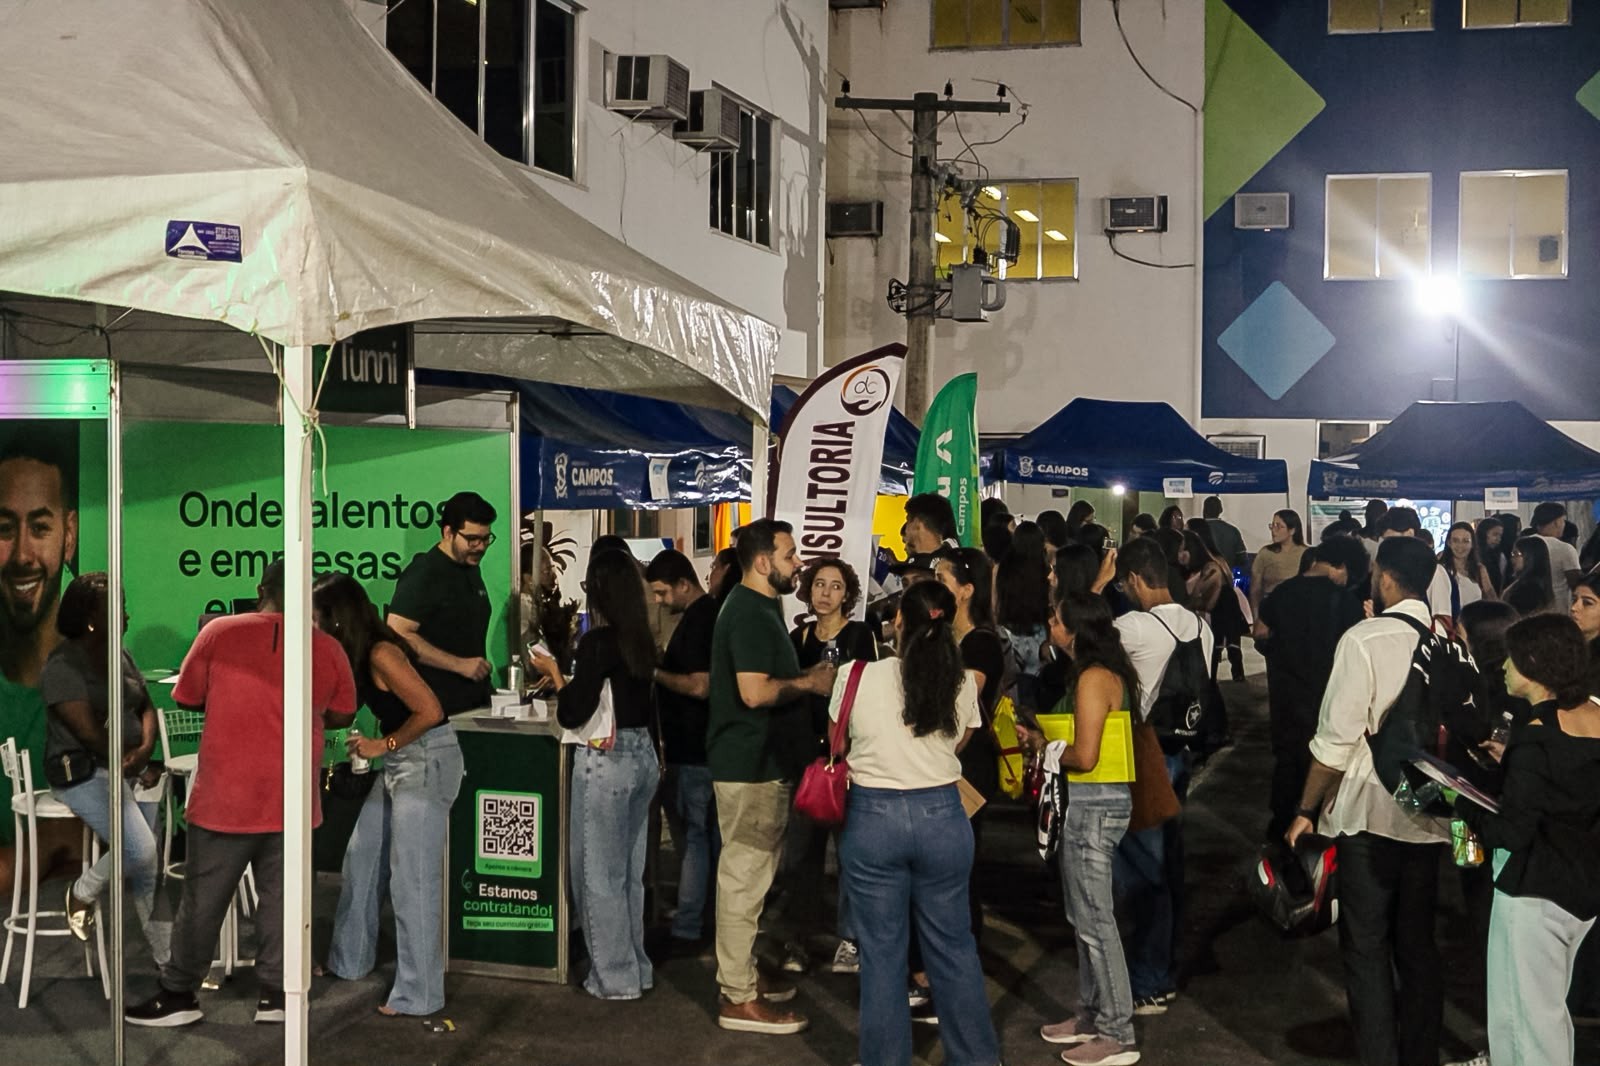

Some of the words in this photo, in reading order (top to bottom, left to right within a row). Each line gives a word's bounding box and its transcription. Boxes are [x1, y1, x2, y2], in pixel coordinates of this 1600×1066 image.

[572, 467, 614, 487] CAMPOS
[1037, 464, 1089, 477] CAMPOS
[1343, 479, 1398, 489] CAMPOS
[179, 490, 283, 529] Onde
[956, 477, 969, 537] Campos
[178, 549, 201, 577] e
[478, 883, 538, 901] Estamos
[463, 900, 553, 917] contratando!
